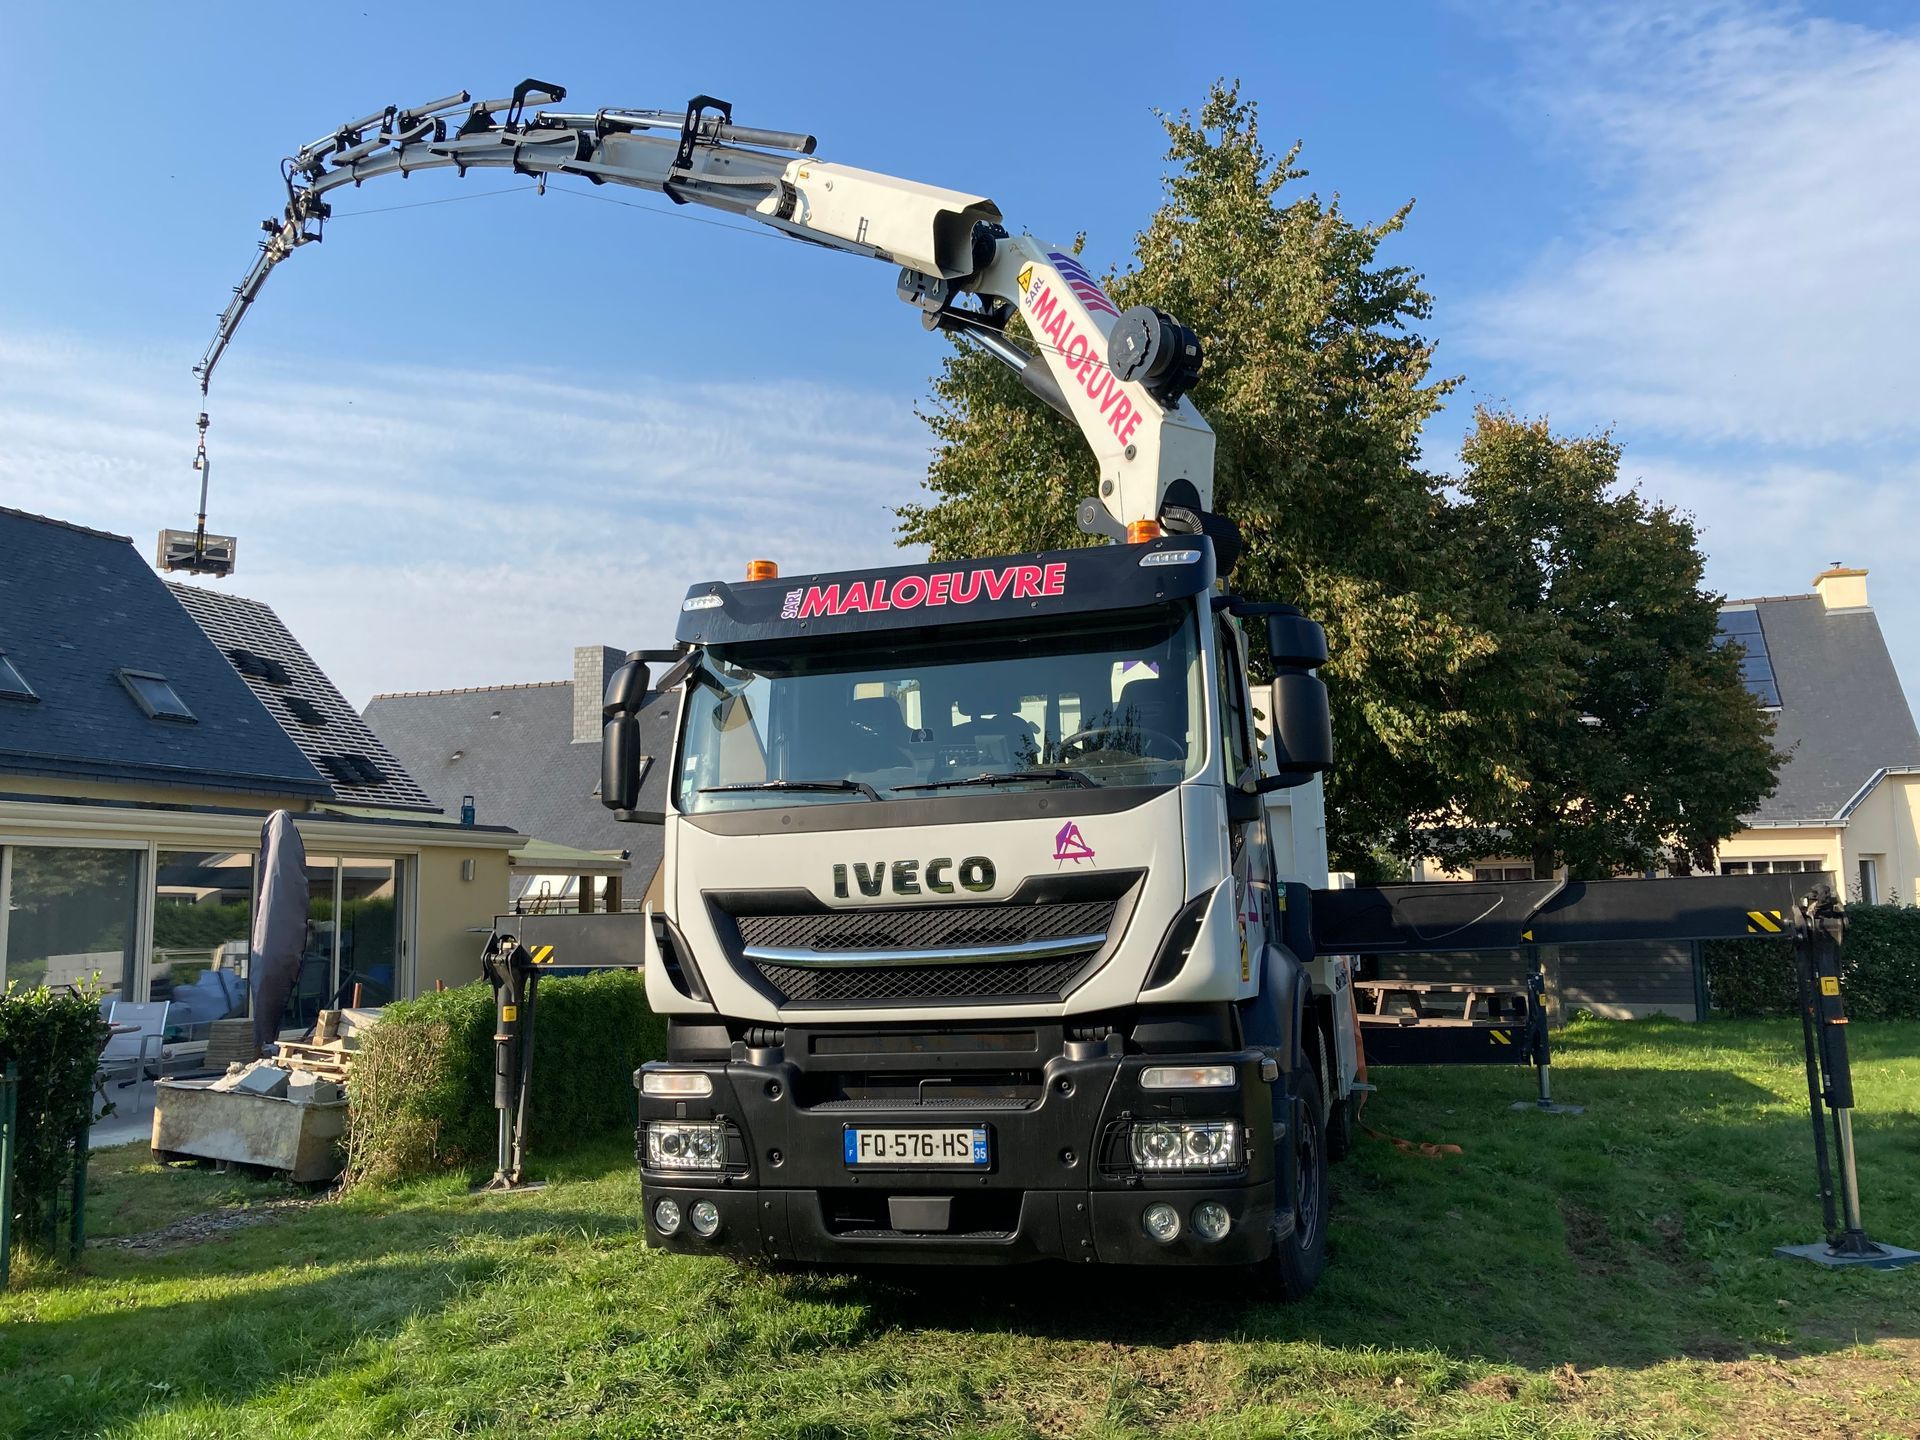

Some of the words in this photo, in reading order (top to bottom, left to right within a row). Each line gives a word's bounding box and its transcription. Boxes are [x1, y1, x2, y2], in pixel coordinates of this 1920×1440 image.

[1025, 277, 1045, 308] SARL
[1031, 287, 1143, 447] MALOEUVRE
[781, 588, 803, 619] SARL
[798, 563, 1067, 618] MALOEUVRE
[833, 856, 996, 898] IVECO
[974, 1147, 986, 1159] 35
